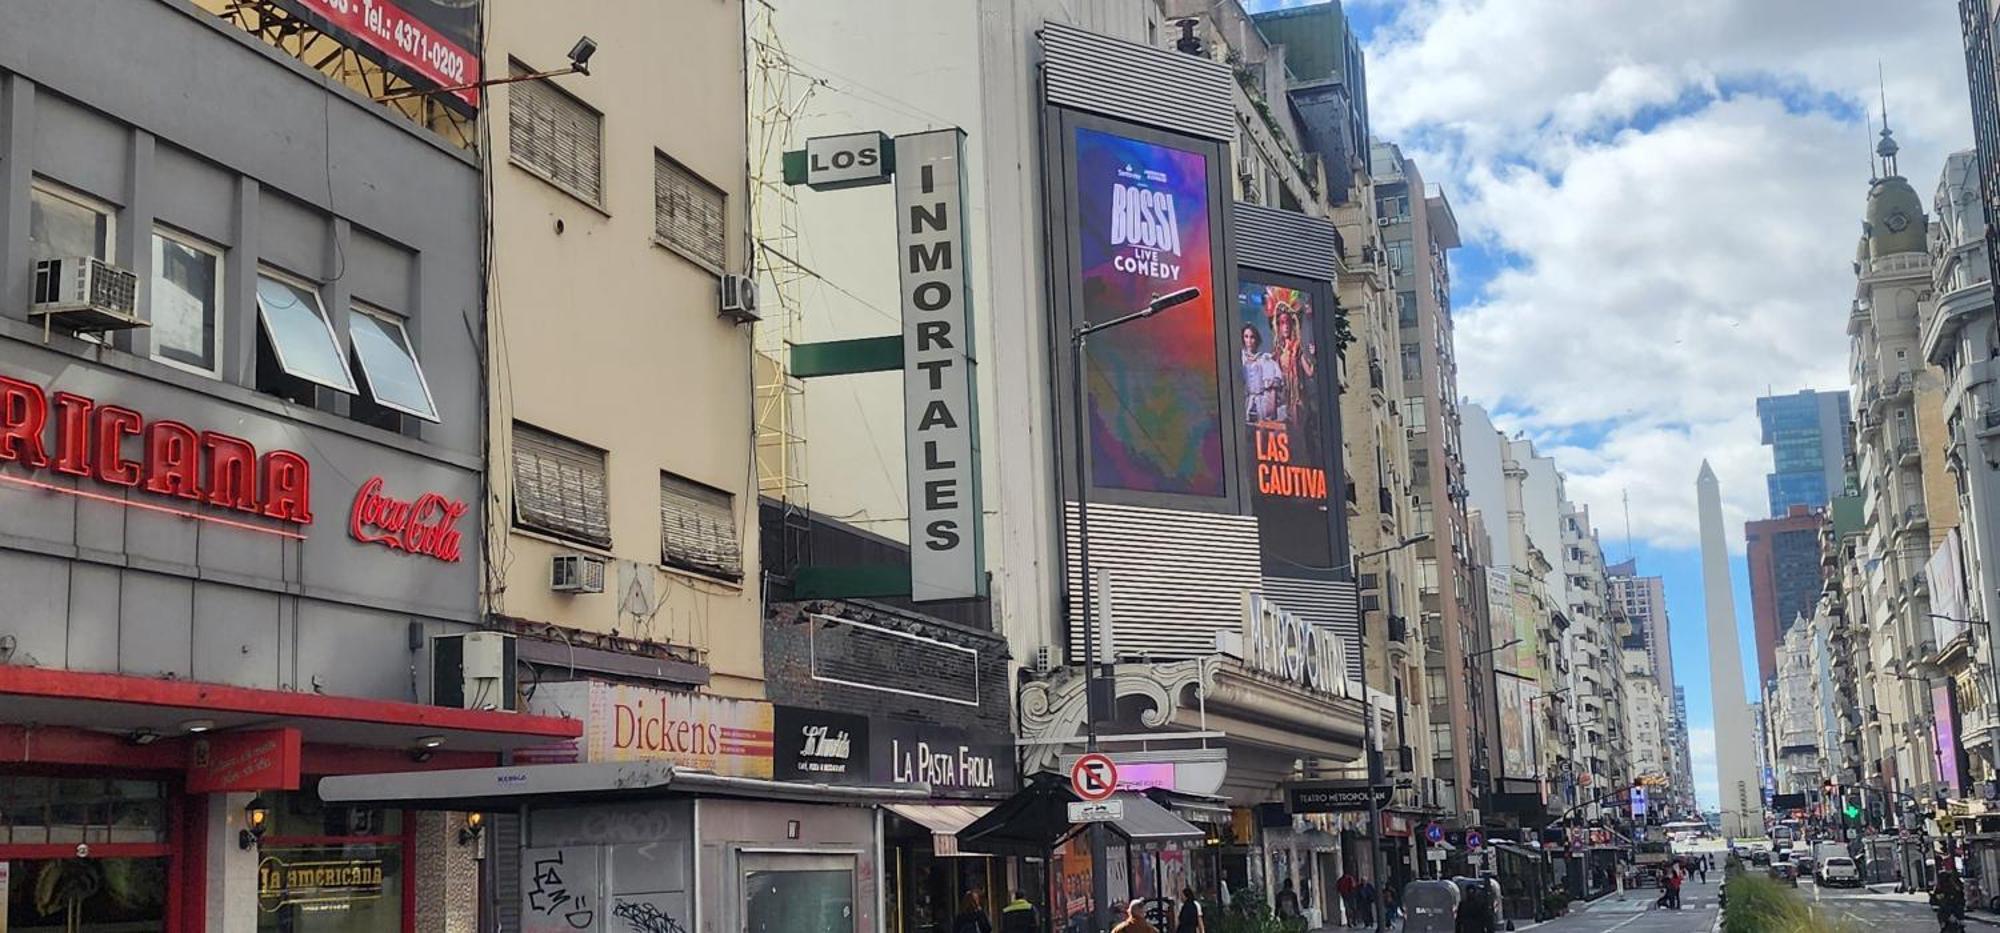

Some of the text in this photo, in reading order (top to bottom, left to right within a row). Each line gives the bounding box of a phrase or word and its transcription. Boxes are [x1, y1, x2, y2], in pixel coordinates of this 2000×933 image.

[363, 0, 391, 41] Tel.:
[395, 19, 464, 84] 4371-0202
[811, 148, 879, 172] LOS
[1111, 183, 1181, 257] BOSSI
[1114, 255, 1180, 281] COMEDY
[1135, 248, 1159, 262] LIVE
[909, 164, 960, 551] INMORTALES
[1256, 430, 1290, 463] LAS
[1258, 464, 1327, 499] CAUTIVA
[614, 697, 718, 755] Dickens
[893, 740, 913, 783] LA
[918, 742, 955, 785] PASTA
[959, 746, 994, 787] FROLA
[1328, 791, 1385, 802] METROPOLAN
